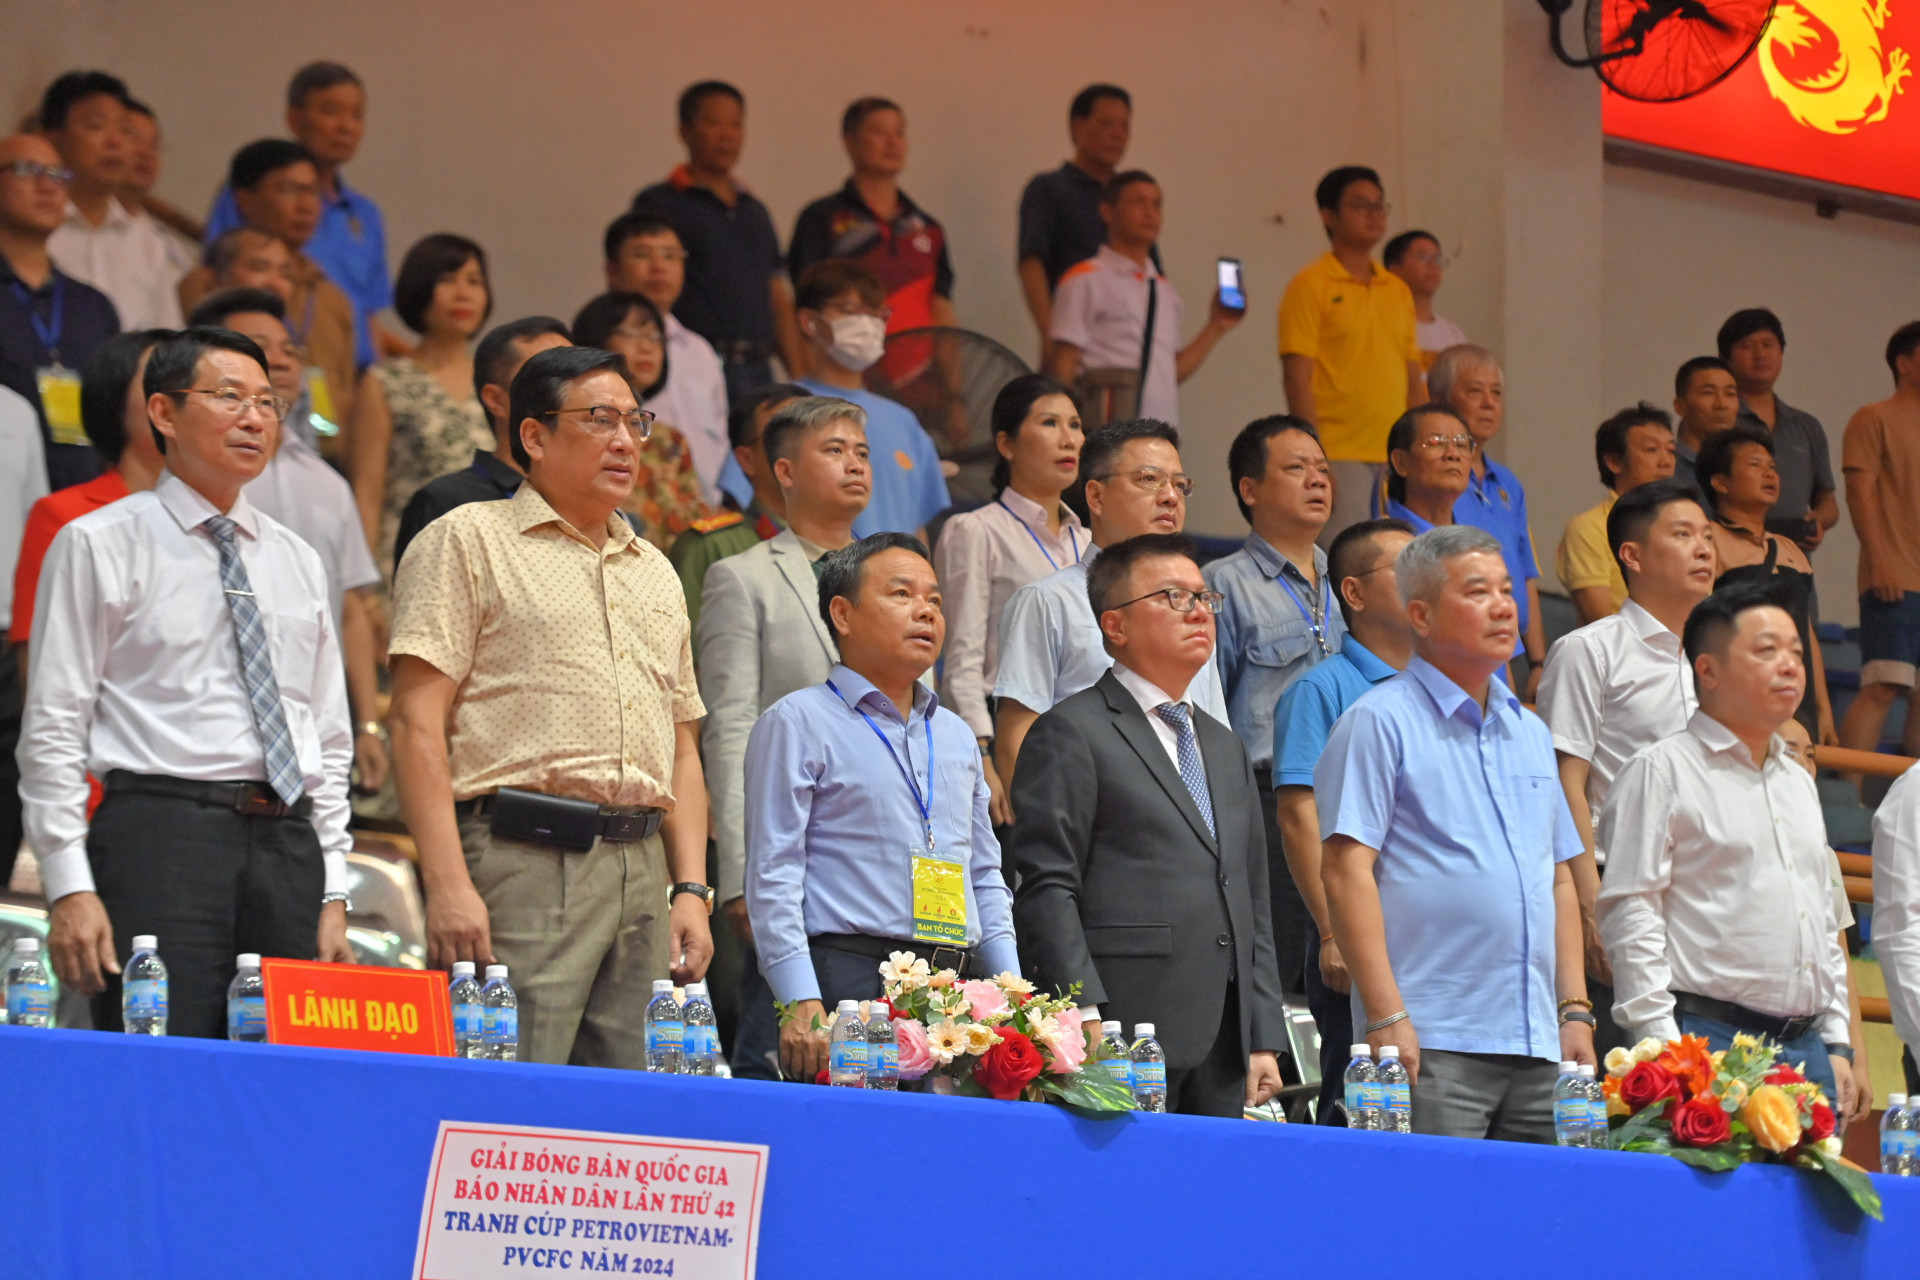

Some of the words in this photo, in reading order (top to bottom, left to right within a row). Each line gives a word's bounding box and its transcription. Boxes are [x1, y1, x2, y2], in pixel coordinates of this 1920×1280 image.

[917, 922, 932, 932] BAN
[287, 990, 359, 1030] LÃNH
[365, 1000, 419, 1040] ĐẠO
[470, 1141, 518, 1170] GIẢI
[522, 1147, 581, 1175] BÓNG
[585, 1152, 631, 1178] BÀN
[635, 1153, 690, 1186] QUỐC
[694, 1165, 729, 1186] GIA
[454, 1174, 499, 1201] BÁO
[504, 1179, 567, 1205] NHÂN
[571, 1182, 618, 1208] DÂN
[714, 1200, 735, 1219] 42
[444, 1211, 519, 1234] TRANH
[524, 1210, 567, 1237] CÚP
[571, 1218, 734, 1247] PETROVIETNAM-
[503, 1246, 573, 1269] PVCFC
[580, 1246, 628, 1273] NĂM
[631, 1257, 674, 1278] 2024
